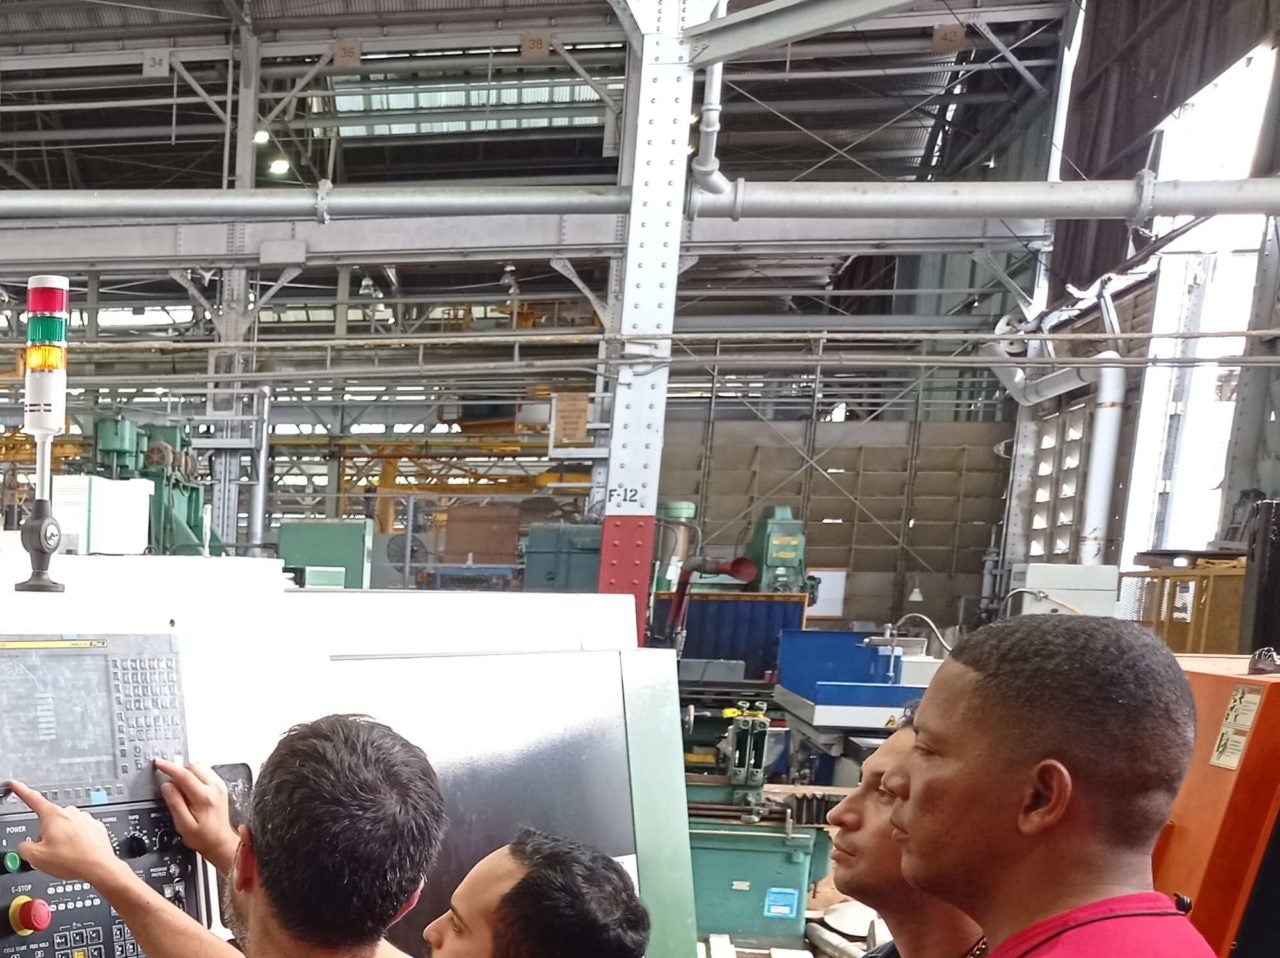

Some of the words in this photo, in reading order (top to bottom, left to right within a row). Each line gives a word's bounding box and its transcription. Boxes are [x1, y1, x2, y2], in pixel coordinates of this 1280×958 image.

[528, 38, 543, 49] 38
[340, 47, 355, 58] 36
[149, 57, 164, 68] 34
[608, 488, 638, 503] F-12
[6, 825, 26, 833] POWER
[11, 885, 32, 893] E-STOP
